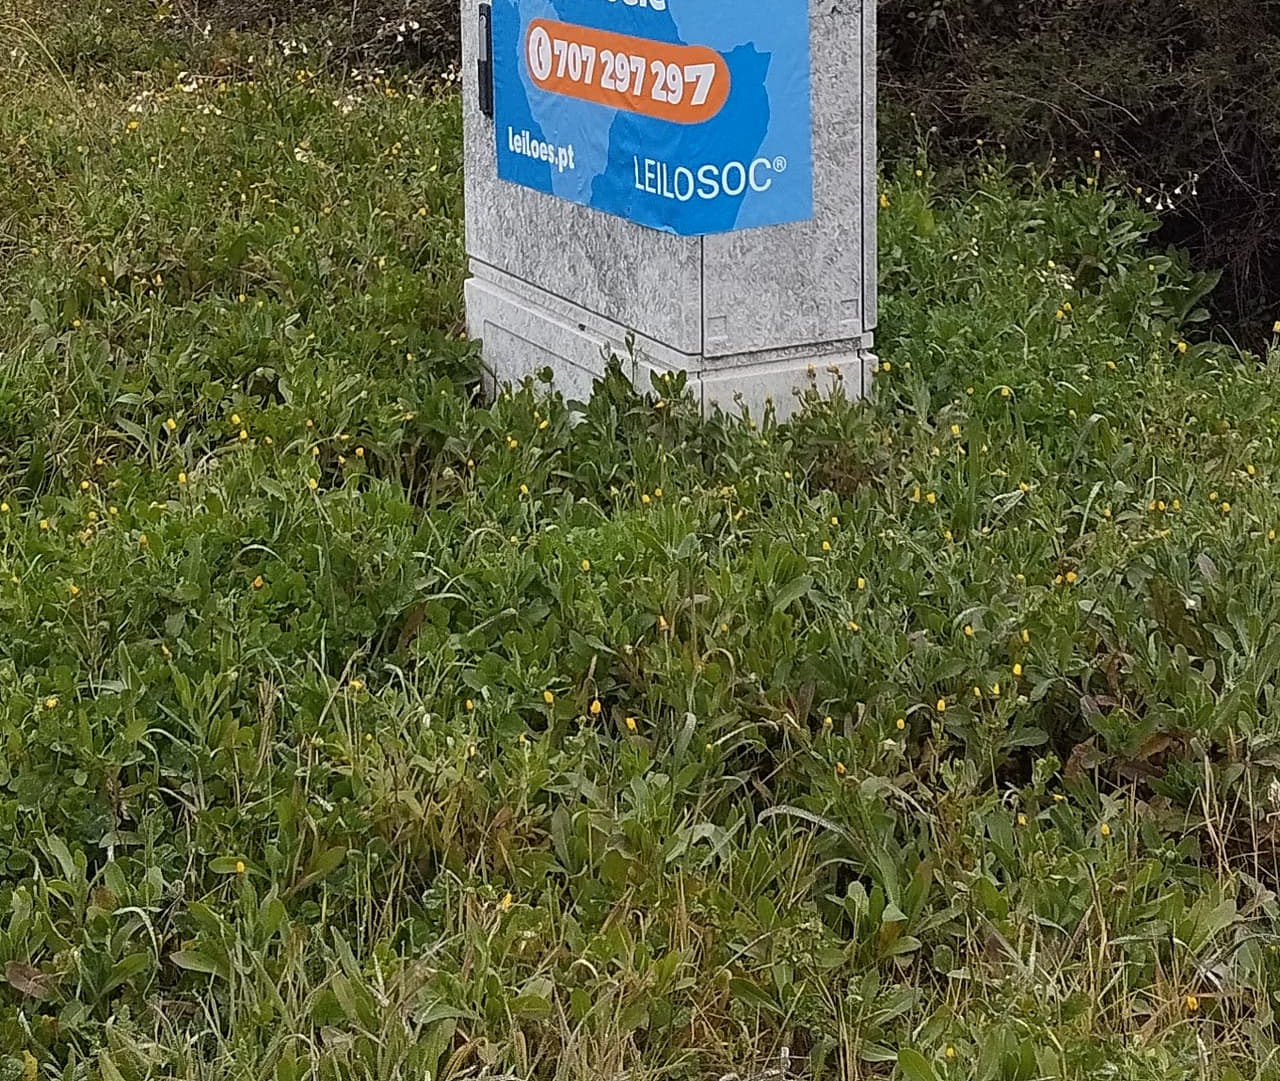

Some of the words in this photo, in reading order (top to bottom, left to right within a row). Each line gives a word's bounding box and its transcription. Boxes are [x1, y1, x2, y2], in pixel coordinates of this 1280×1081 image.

[554, 39, 596, 85] 707
[599, 49, 646, 97] 297
[651, 60, 716, 107] 297
[507, 126, 575, 173] leiloes.pt
